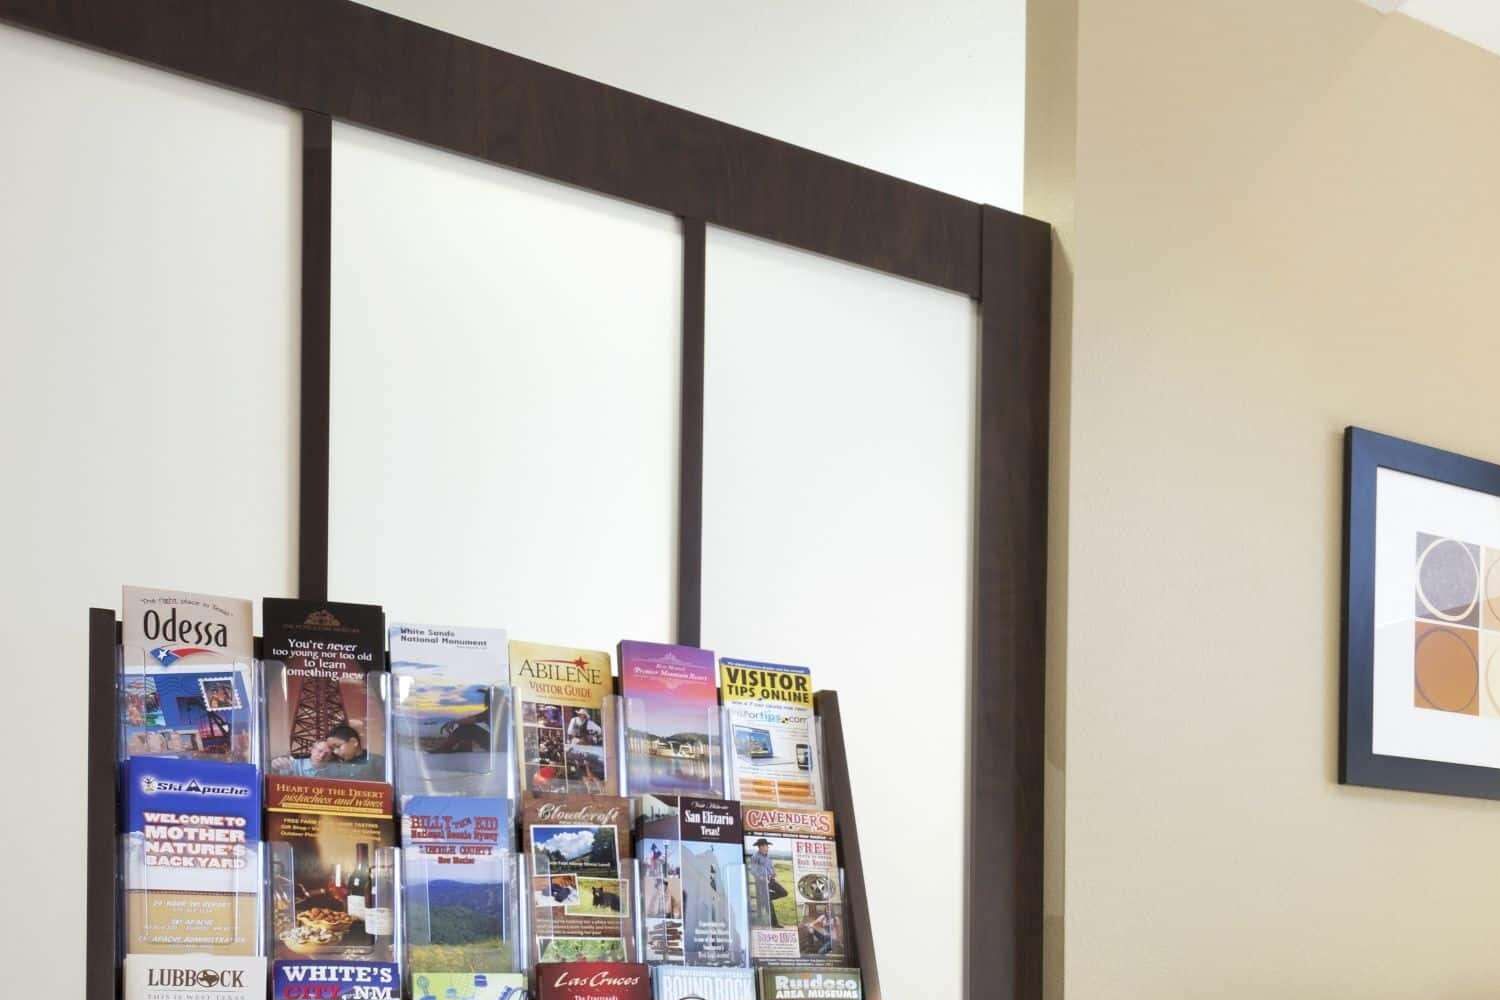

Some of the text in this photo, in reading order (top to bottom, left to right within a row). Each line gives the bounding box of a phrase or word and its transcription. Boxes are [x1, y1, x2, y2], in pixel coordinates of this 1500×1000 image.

[143, 607, 227, 647] Odessa
[400, 627, 455, 637] White Sands
[288, 639, 358, 652] You're never
[400, 635, 438, 644] National
[441, 637, 488, 647] Monument
[272, 648, 372, 661] too young nor too old
[304, 659, 346, 670] to learn
[518, 658, 602, 686] ABILENE
[342, 671, 364, 680] new
[725, 666, 809, 692] VISITOR
[529, 679, 592, 699] VISITOR GUIDE
[727, 684, 809, 704] TIPS ONLINE
[156, 782, 183, 792] Ski
[276, 783, 385, 799] HEART OF THE DESERT
[143, 811, 226, 826] WELCOME
[537, 803, 619, 824] Cloudcroft
[684, 809, 734, 826] San Elizario
[747, 810, 831, 833] CAVENDER'S
[143, 824, 247, 843] MOTHER
[144, 841, 247, 857] NATURE'S
[796, 841, 832, 855] FREE
[147, 968, 245, 988] LUBBOCK
[282, 965, 393, 983] WHITE'S
[554, 970, 641, 988] Las Cruces
[775, 972, 858, 990] Ruidoso
[352, 985, 393, 1000] NM
[775, 989, 858, 1000] AREA MUSEUMS
